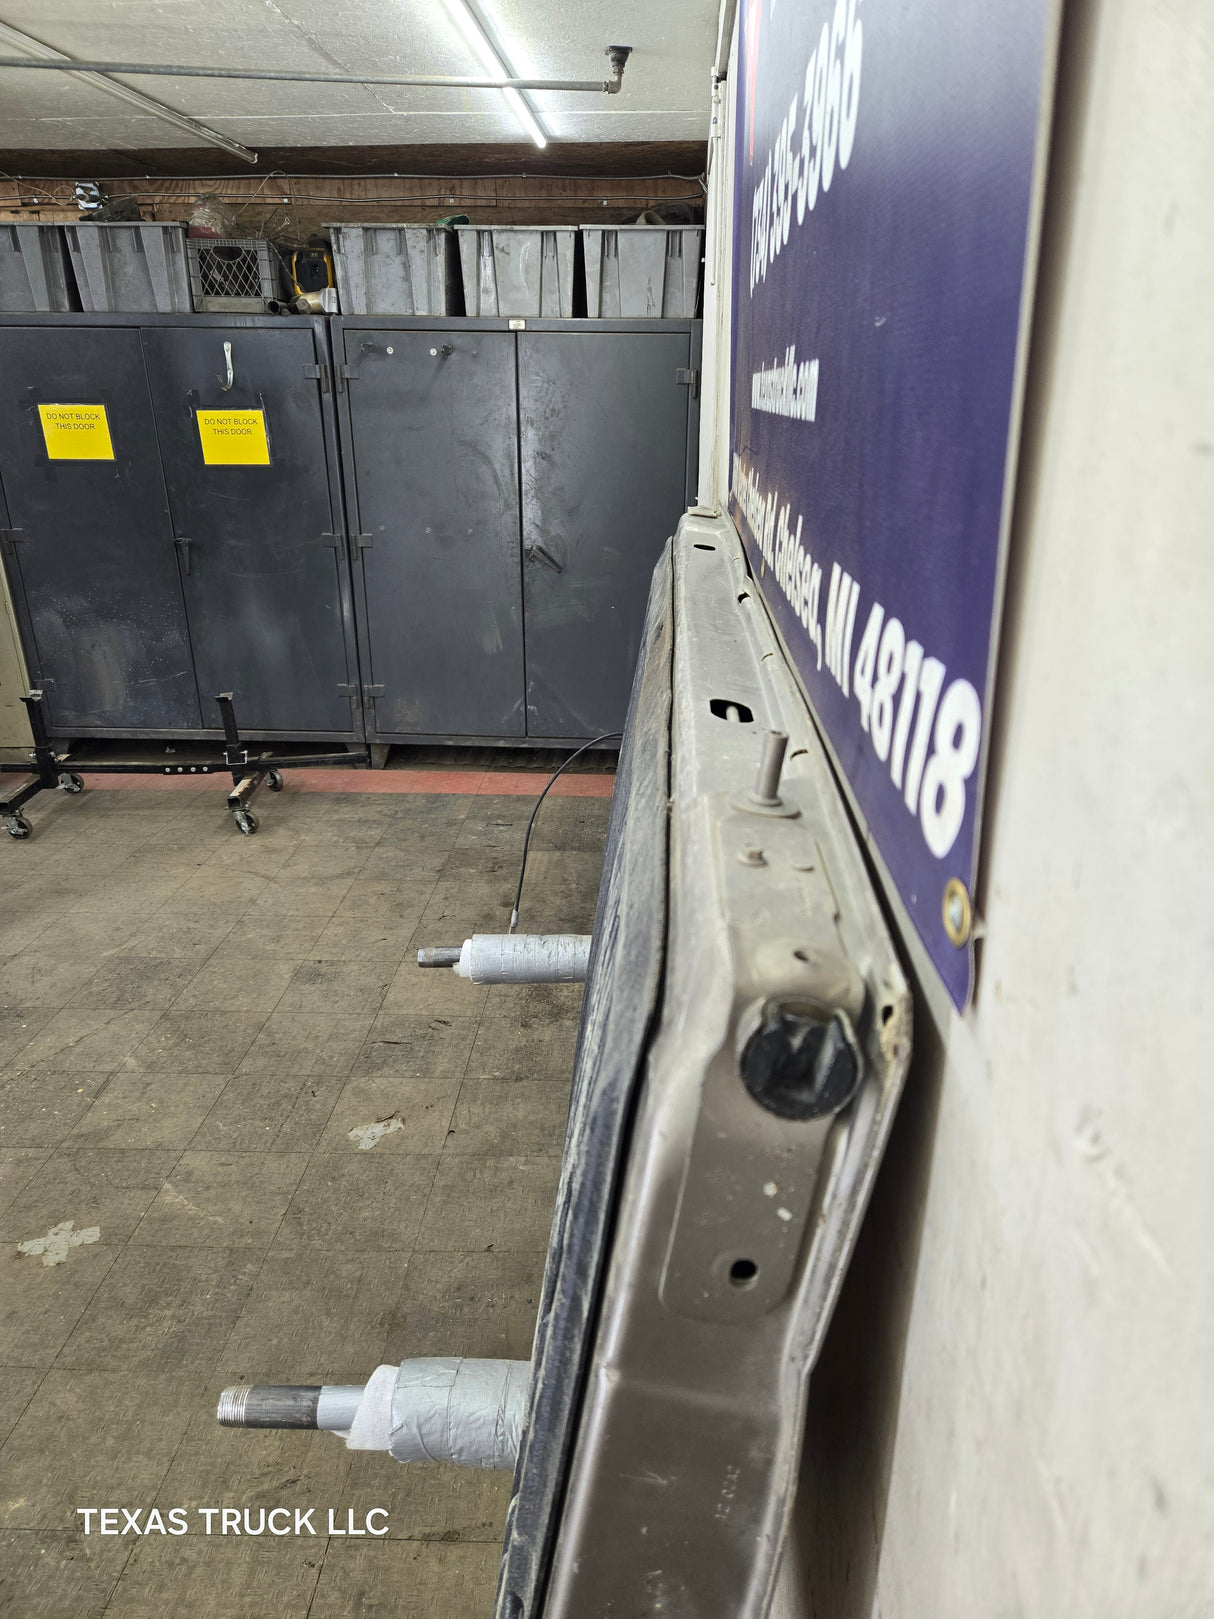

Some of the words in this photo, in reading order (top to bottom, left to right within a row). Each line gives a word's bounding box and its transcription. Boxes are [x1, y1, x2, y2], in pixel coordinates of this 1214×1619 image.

[769, 0, 863, 264] 395-3966
[46, 412, 57, 420] DO
[58, 412, 74, 420] NOT
[75, 412, 101, 420] BLOCK
[55, 422, 72, 430] THIS
[775, 503, 822, 671] Chelsea,
[824, 561, 861, 698] MI
[854, 602, 982, 858] 48118
